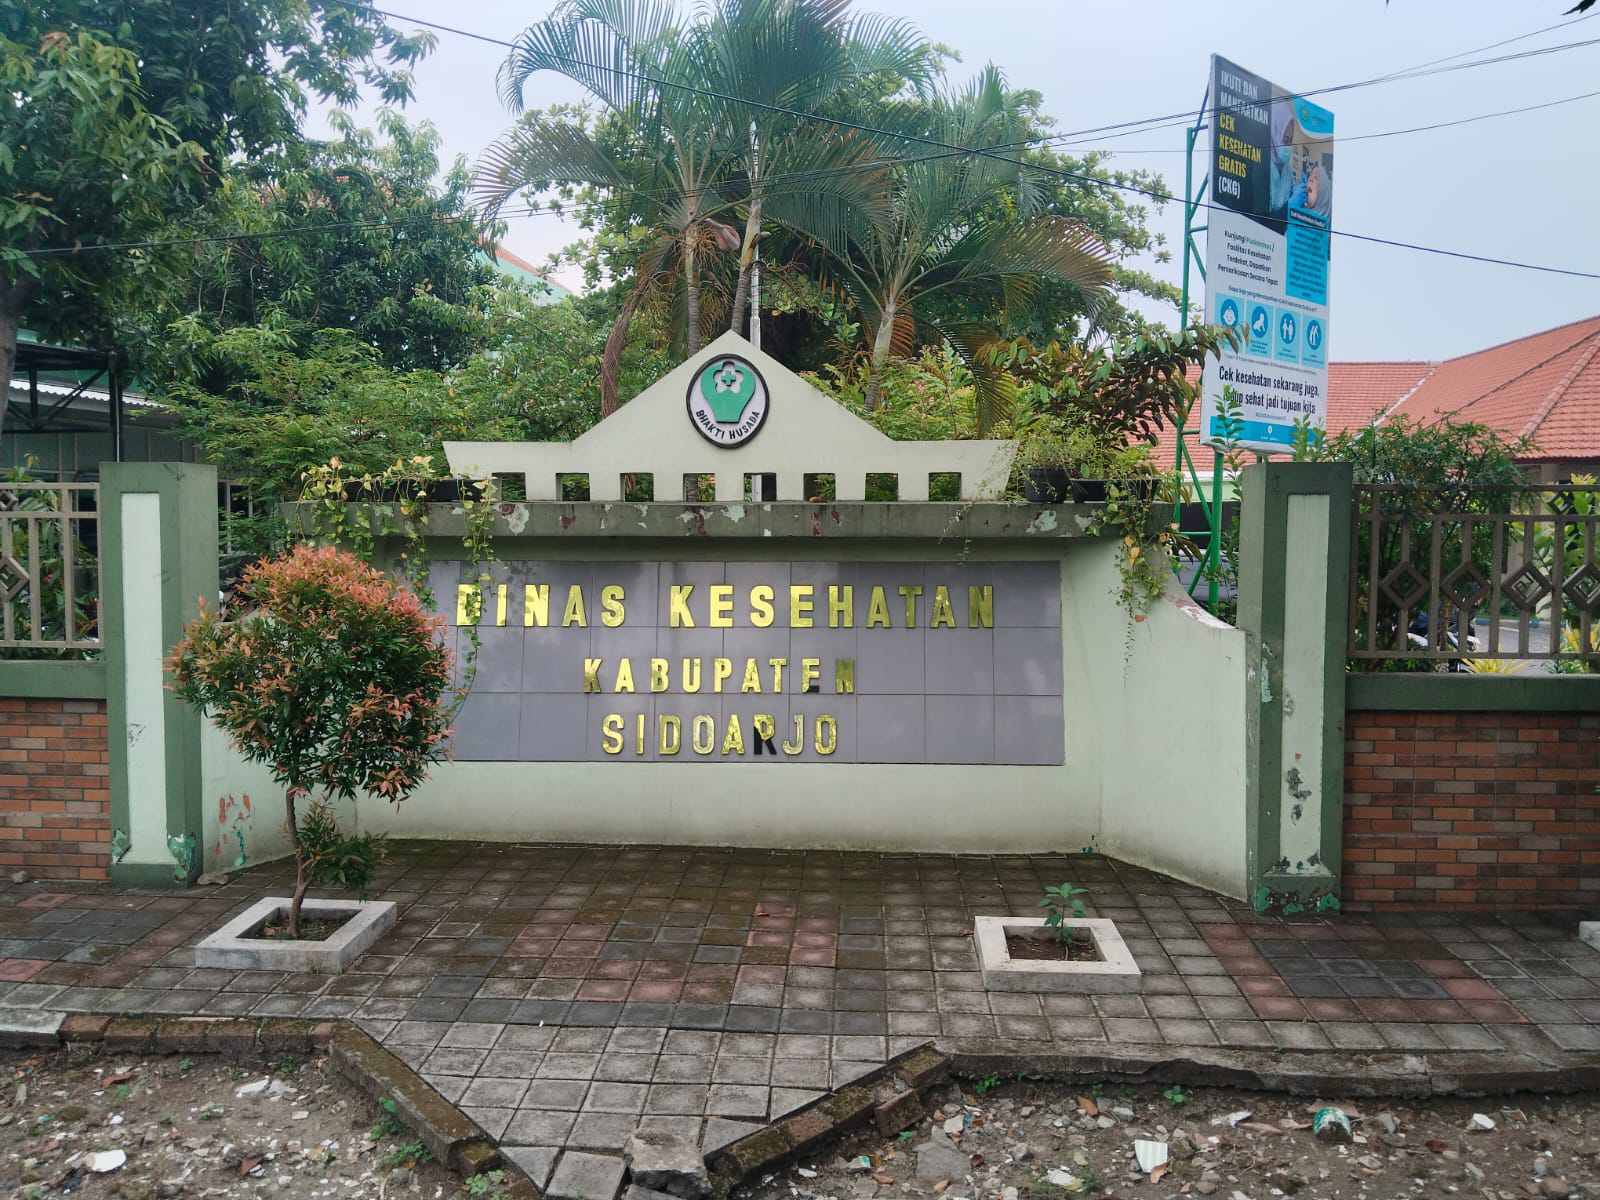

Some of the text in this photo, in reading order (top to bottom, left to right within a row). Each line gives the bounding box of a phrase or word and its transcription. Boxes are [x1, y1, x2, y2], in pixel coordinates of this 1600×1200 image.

[1220, 70, 1258, 97] IKUTI DAN
[1219, 113, 1235, 132] CEK
[1219, 134, 1262, 163] KESEHATAN
[1218, 155, 1247, 178] GRATIS
[1218, 176, 1240, 199] (CKG)
[1219, 365, 1233, 382] Cek
[1236, 369, 1271, 387] kesehatan
[1273, 377, 1303, 396] sekarang
[1245, 390, 1264, 406] sehat
[1265, 394, 1279, 410] jadi
[1280, 397, 1301, 413] tujuan
[1302, 400, 1316, 414] kita
[695, 409, 760, 440] BHAKTI HUSADA
[456, 583, 994, 629] DINAS KESEHATAN
[583, 657, 855, 694] KABUPATEN
[602, 713, 838, 756] SIDOARJO
